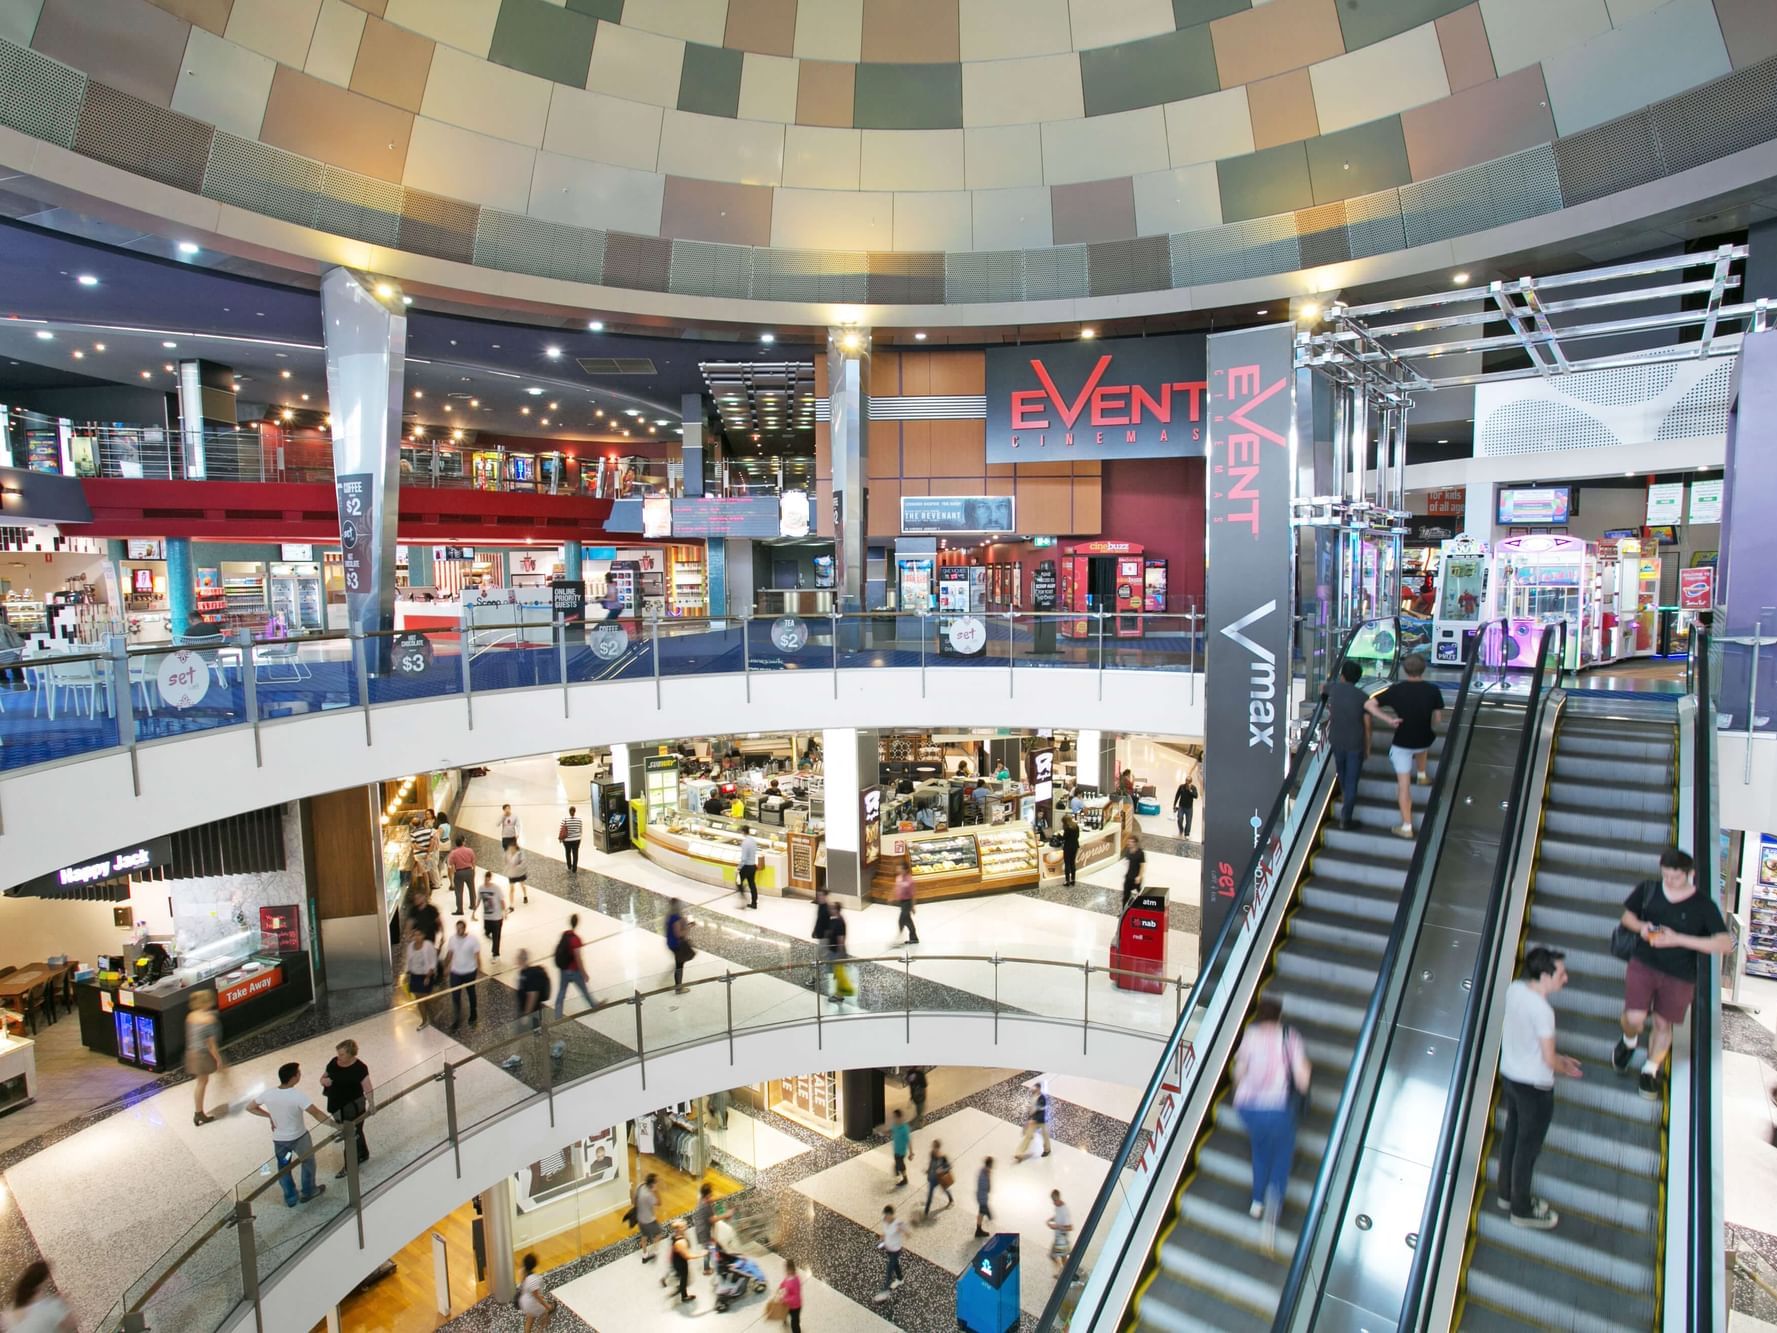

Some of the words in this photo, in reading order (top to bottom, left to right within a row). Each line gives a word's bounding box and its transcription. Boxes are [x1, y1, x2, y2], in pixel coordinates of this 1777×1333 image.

[1011, 354, 1209, 430] EVENT
[1011, 428, 1201, 448] CINEMAS
[1214, 369, 1224, 523] CINEMAS
[1228, 364, 1287, 535] EVENT
[343, 481, 363, 493] COFFEE
[346, 498, 362, 516] $2
[905, 511, 919, 520] THE
[921, 511, 961, 520] REVENANT
[1429, 500, 1438, 512] of
[1451, 503, 1465, 514] age
[343, 526, 353, 540] set
[1089, 542, 1129, 550] cinebuzz
[346, 572, 359, 590] $3
[784, 619, 795, 627] TEA
[780, 633, 798, 648] $2
[956, 627, 976, 640] set
[600, 640, 618, 656] $2
[402, 654, 425, 672] $3
[168, 666, 196, 687] set
[1219, 599, 1276, 748] Vmax
[59, 861, 110, 885] Happy
[1141, 919, 1157, 928] nab
[226, 988, 248, 1002] Take
[249, 977, 272, 993] Away
